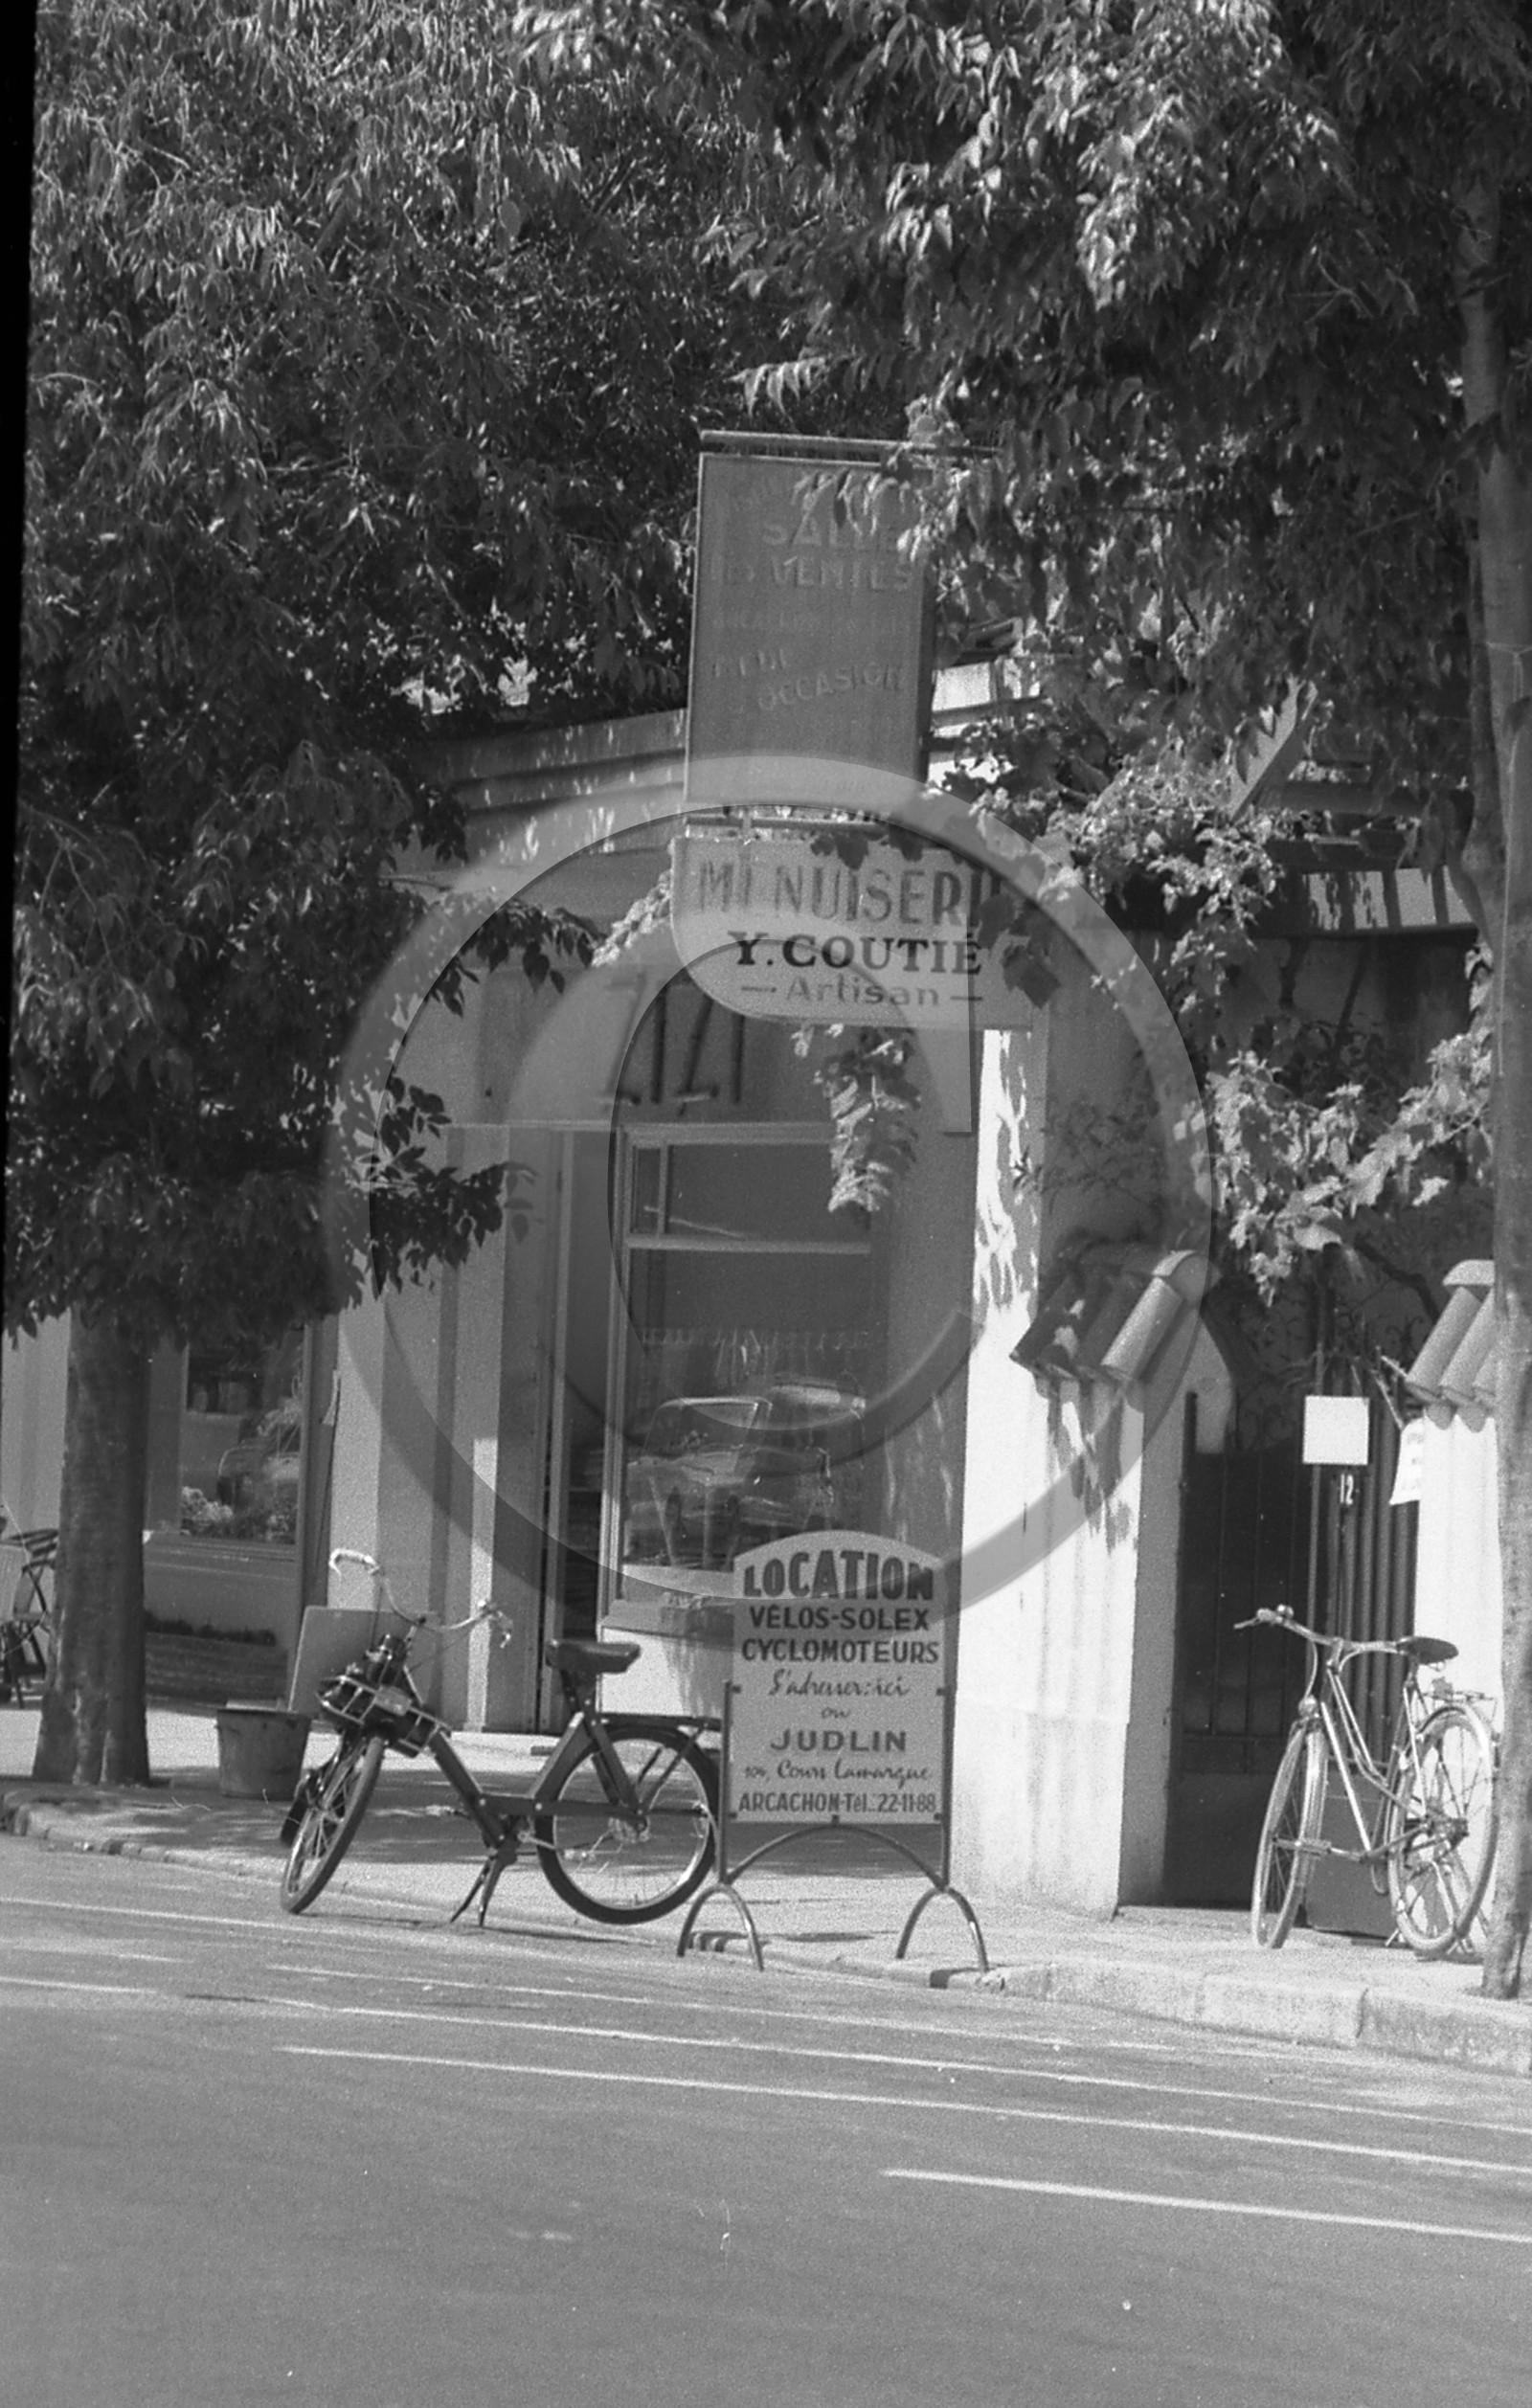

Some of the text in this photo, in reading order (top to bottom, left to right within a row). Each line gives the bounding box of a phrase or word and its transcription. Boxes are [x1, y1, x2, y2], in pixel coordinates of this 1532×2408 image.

[786, 974, 939, 1005] Artisan
[744, 1549, 935, 1601] LOCATION
[742, 1638, 939, 1663] CYCLOMOTEURS
[821, 1706, 852, 1719] ou
[770, 1729, 908, 1752] JUDLIN
[777, 1759, 826, 1780] Cours
